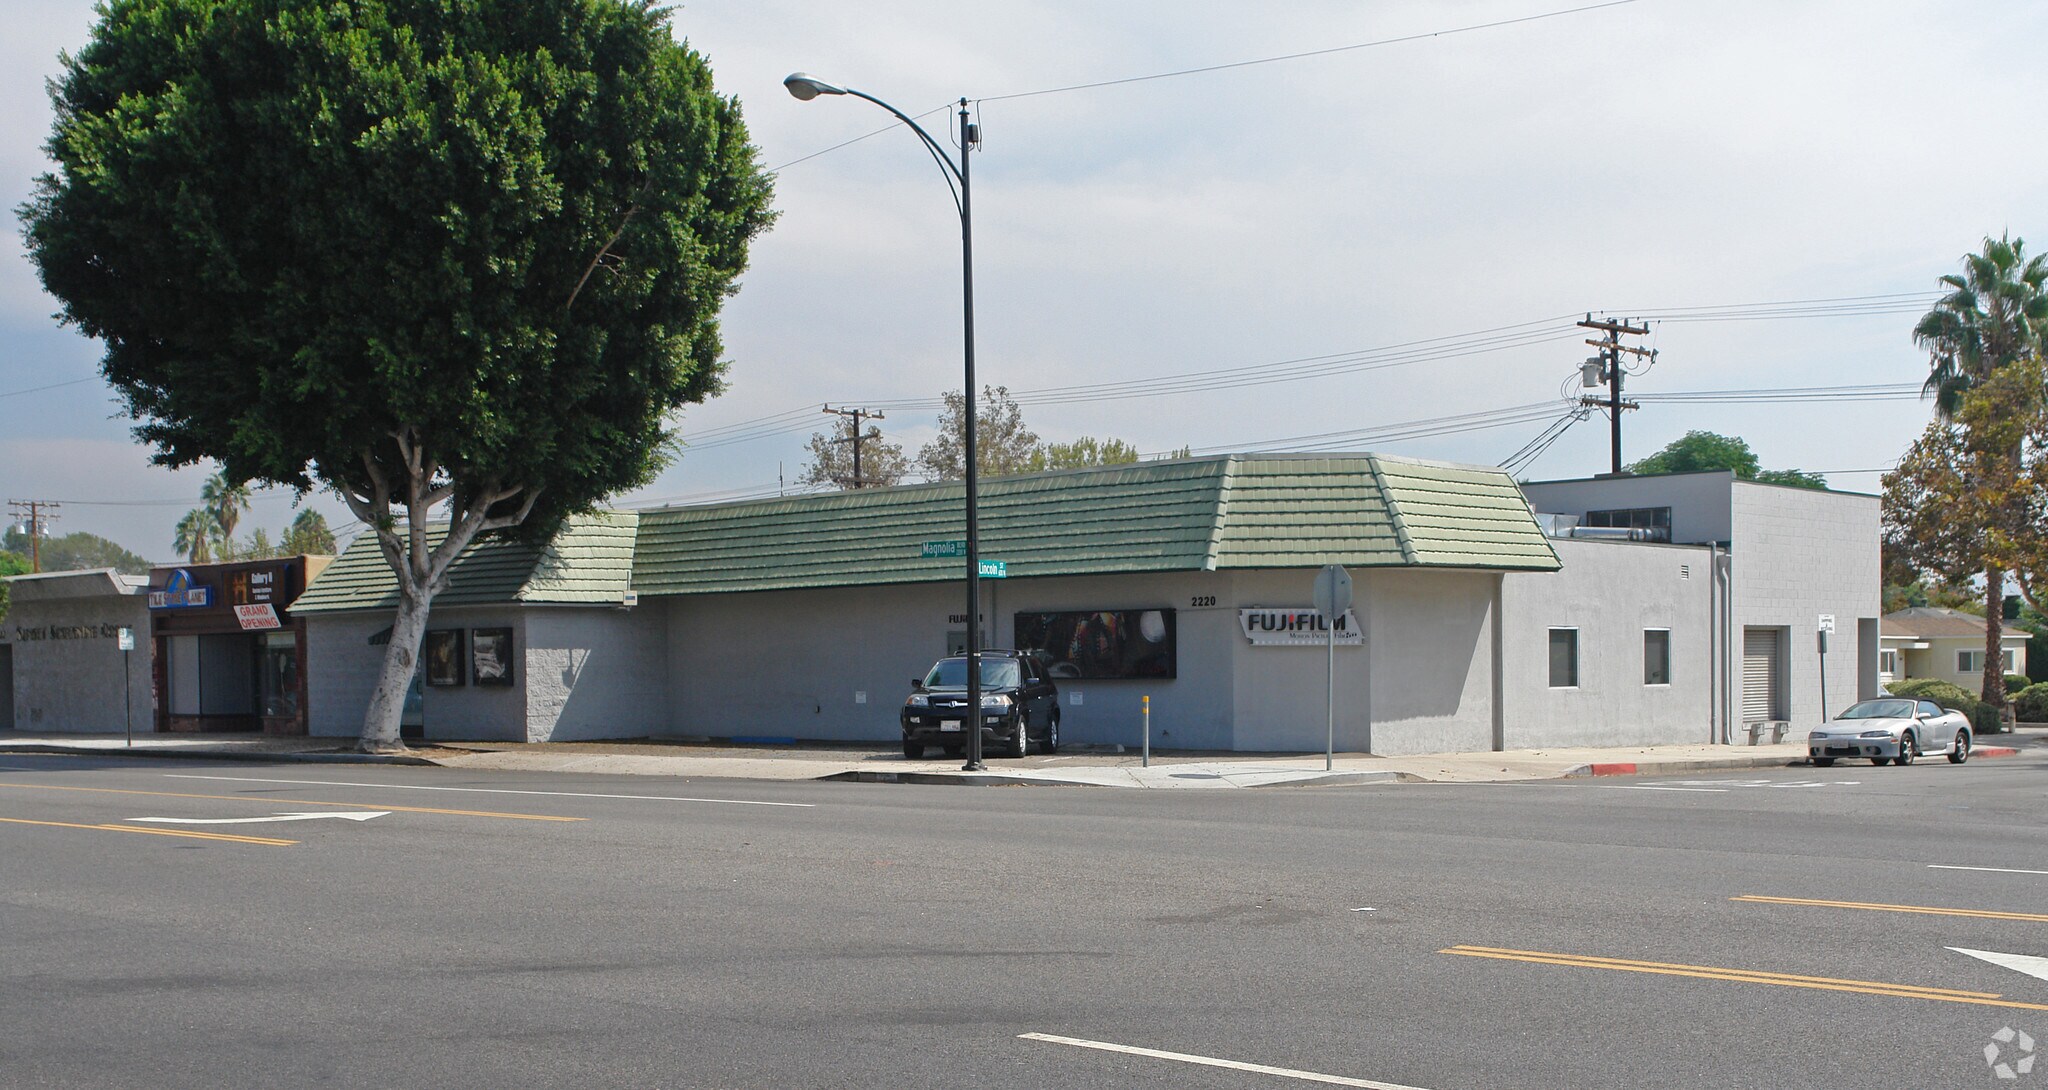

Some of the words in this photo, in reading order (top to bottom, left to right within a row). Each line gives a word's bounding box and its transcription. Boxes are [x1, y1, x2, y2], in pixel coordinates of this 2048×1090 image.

[922, 542, 955, 556] Magnolia
[978, 562, 998, 575] Lincoln
[1191, 596, 1216, 606] 2220
[239, 605, 268, 616] GRAND
[241, 617, 279, 629] OPENING
